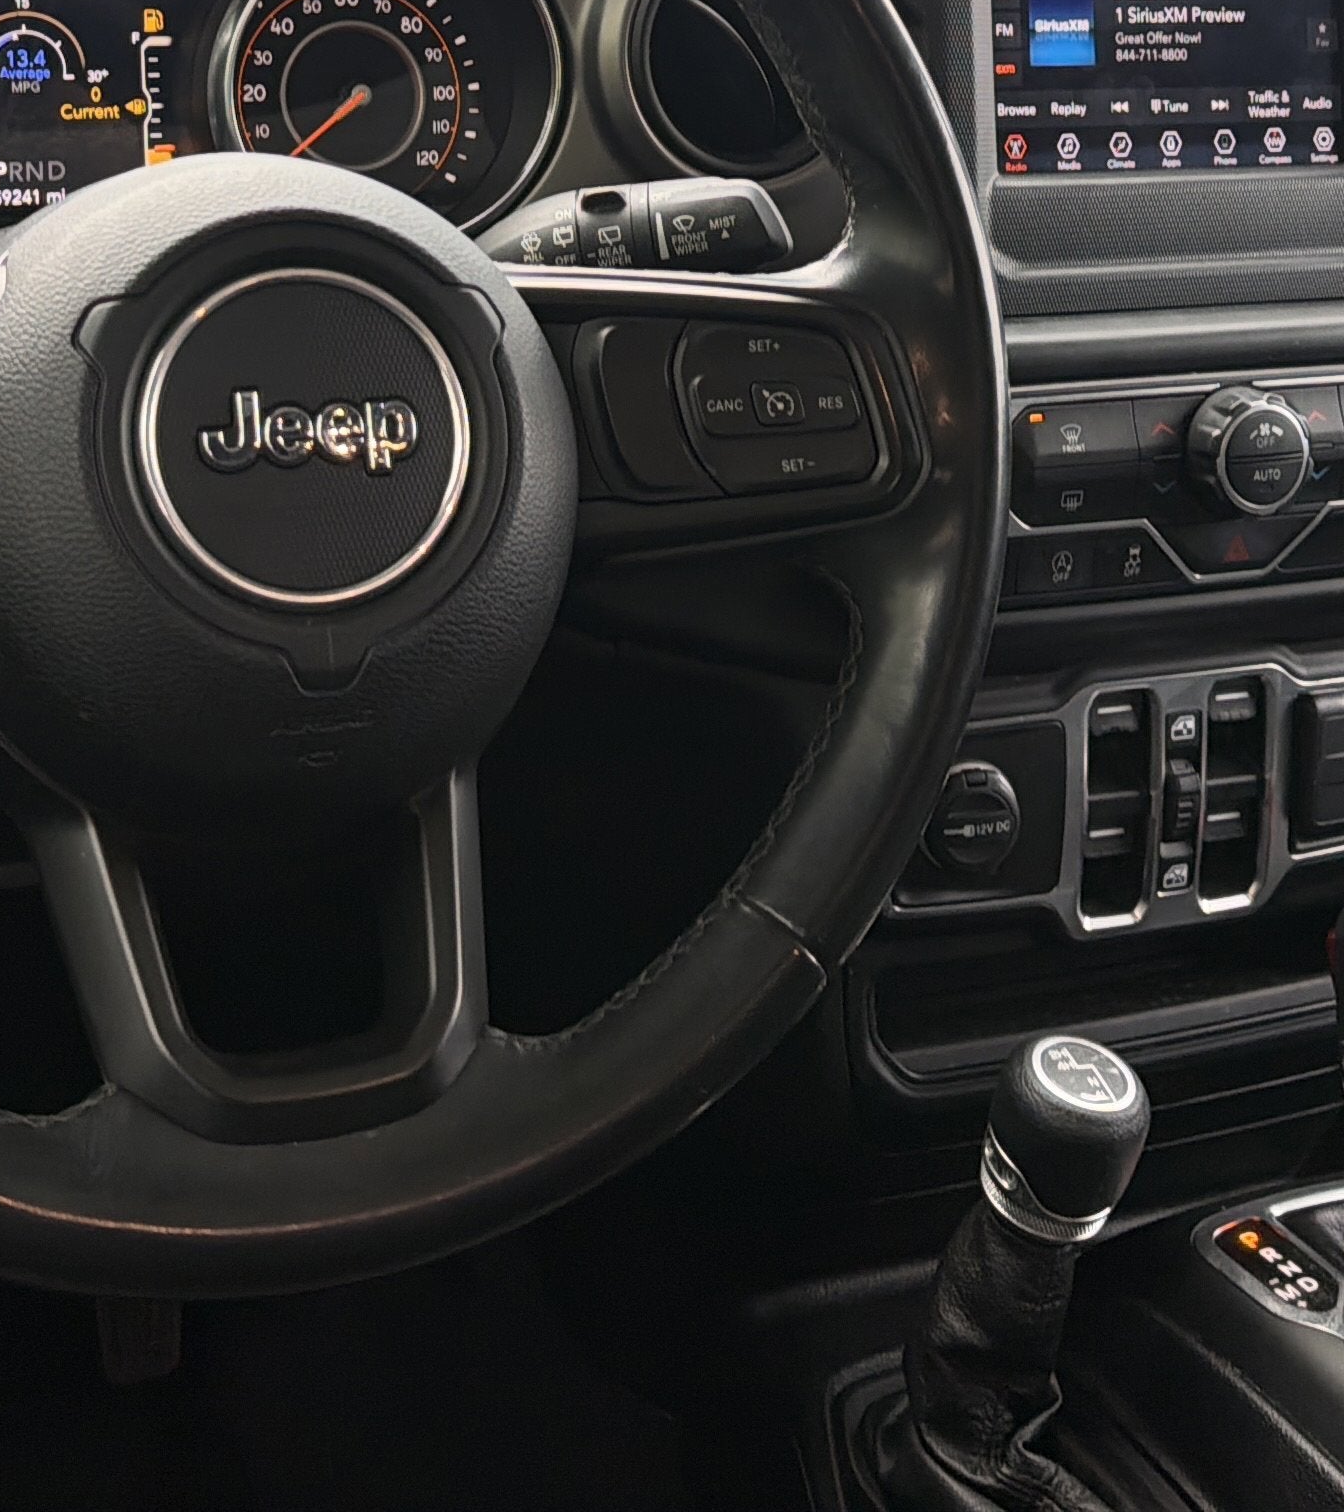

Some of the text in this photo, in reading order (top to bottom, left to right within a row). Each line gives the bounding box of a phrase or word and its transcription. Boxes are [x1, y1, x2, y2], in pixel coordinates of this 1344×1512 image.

[302, 0, 322, 14] 50
[1115, 6, 1246, 24] 1 SiriusXM Preview
[270, 17, 294, 35] 40
[400, 16, 423, 33] 80
[995, 24, 1014, 38] FM
[1034, 19, 1090, 34] SiriusXM
[1115, 31, 1202, 45] Great Offer Now!
[6, 48, 46, 69] 13.4
[254, 50, 273, 65] 30
[424, 47, 443, 62] 90
[1115, 48, 1188, 62] 844-711-8800
[0, 66, 51, 82] Average
[11, 81, 41, 94] MPG
[90, 86, 102, 103] 0
[242, 84, 267, 102] 20
[433, 85, 455, 101] 100
[1248, 91, 1290, 104] Traffic &
[1302, 97, 1333, 111] Audio
[60, 103, 121, 121] Current
[997, 103, 1037, 117] Browse
[1050, 102, 1087, 117] Replay
[1162, 99, 1189, 113] Tune
[1248, 105, 1291, 119] Weather
[255, 123, 270, 138] 10
[432, 120, 450, 134] 110
[416, 149, 439, 166] 120
[1005, 162, 1028, 173] Radio
[554, 208, 572, 221] ON
[709, 215, 736, 230] MIST
[671, 231, 707, 245] FRONT
[598, 244, 626, 257] REAR
[673, 242, 709, 257] WIPER
[554, 254, 576, 265] OFF
[597, 254, 632, 267] WIPER
[707, 397, 744, 413] CANC
[818, 396, 843, 410] RES
[197, 390, 418, 476] Jeep
[1256, 436, 1275, 448] OFF
[1253, 468, 1281, 481] AUTO
[975, 819, 1011, 838] 12V DC
